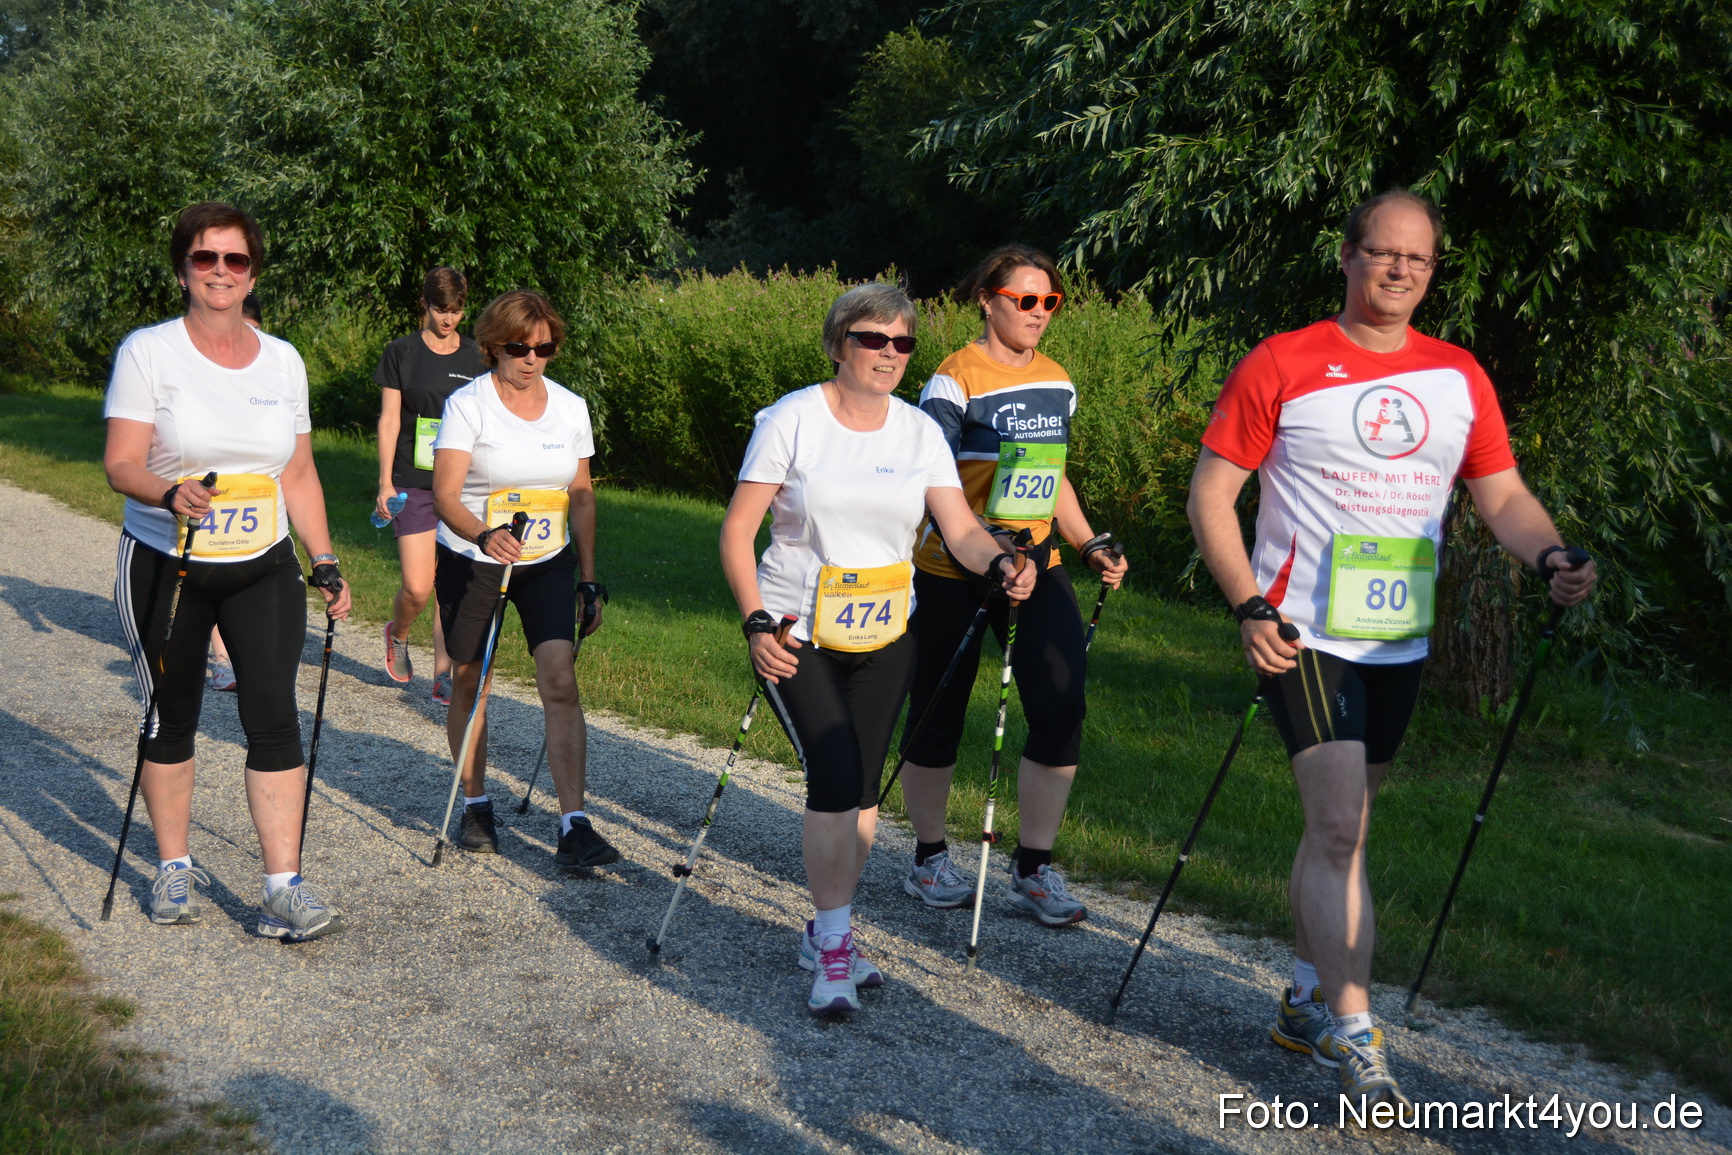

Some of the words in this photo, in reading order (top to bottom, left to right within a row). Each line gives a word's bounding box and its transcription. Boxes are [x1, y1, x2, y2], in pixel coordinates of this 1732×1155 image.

[249, 397, 279, 405] Christine
[1006, 413, 1062, 431] Fischer
[1014, 429, 1062, 439] AUTOMOBILE
[1320, 468, 1378, 482] LAUFEN
[1413, 471, 1441, 486] HERZ
[1001, 473, 1055, 499] 1520
[1335, 488, 1351, 497] Dr.
[1354, 488, 1380, 498] Heck
[1390, 491, 1404, 499] Dr.
[1406, 491, 1431, 501] Röschl
[1335, 501, 1430, 517] Leistungsdiagnostik
[199, 507, 259, 535] 475
[1351, 552, 1391, 561] firmenlauf
[834, 581, 870, 589] firmenlauf
[824, 590, 852, 598] walken
[1365, 578, 1408, 611] 80
[835, 599, 892, 629] 474
